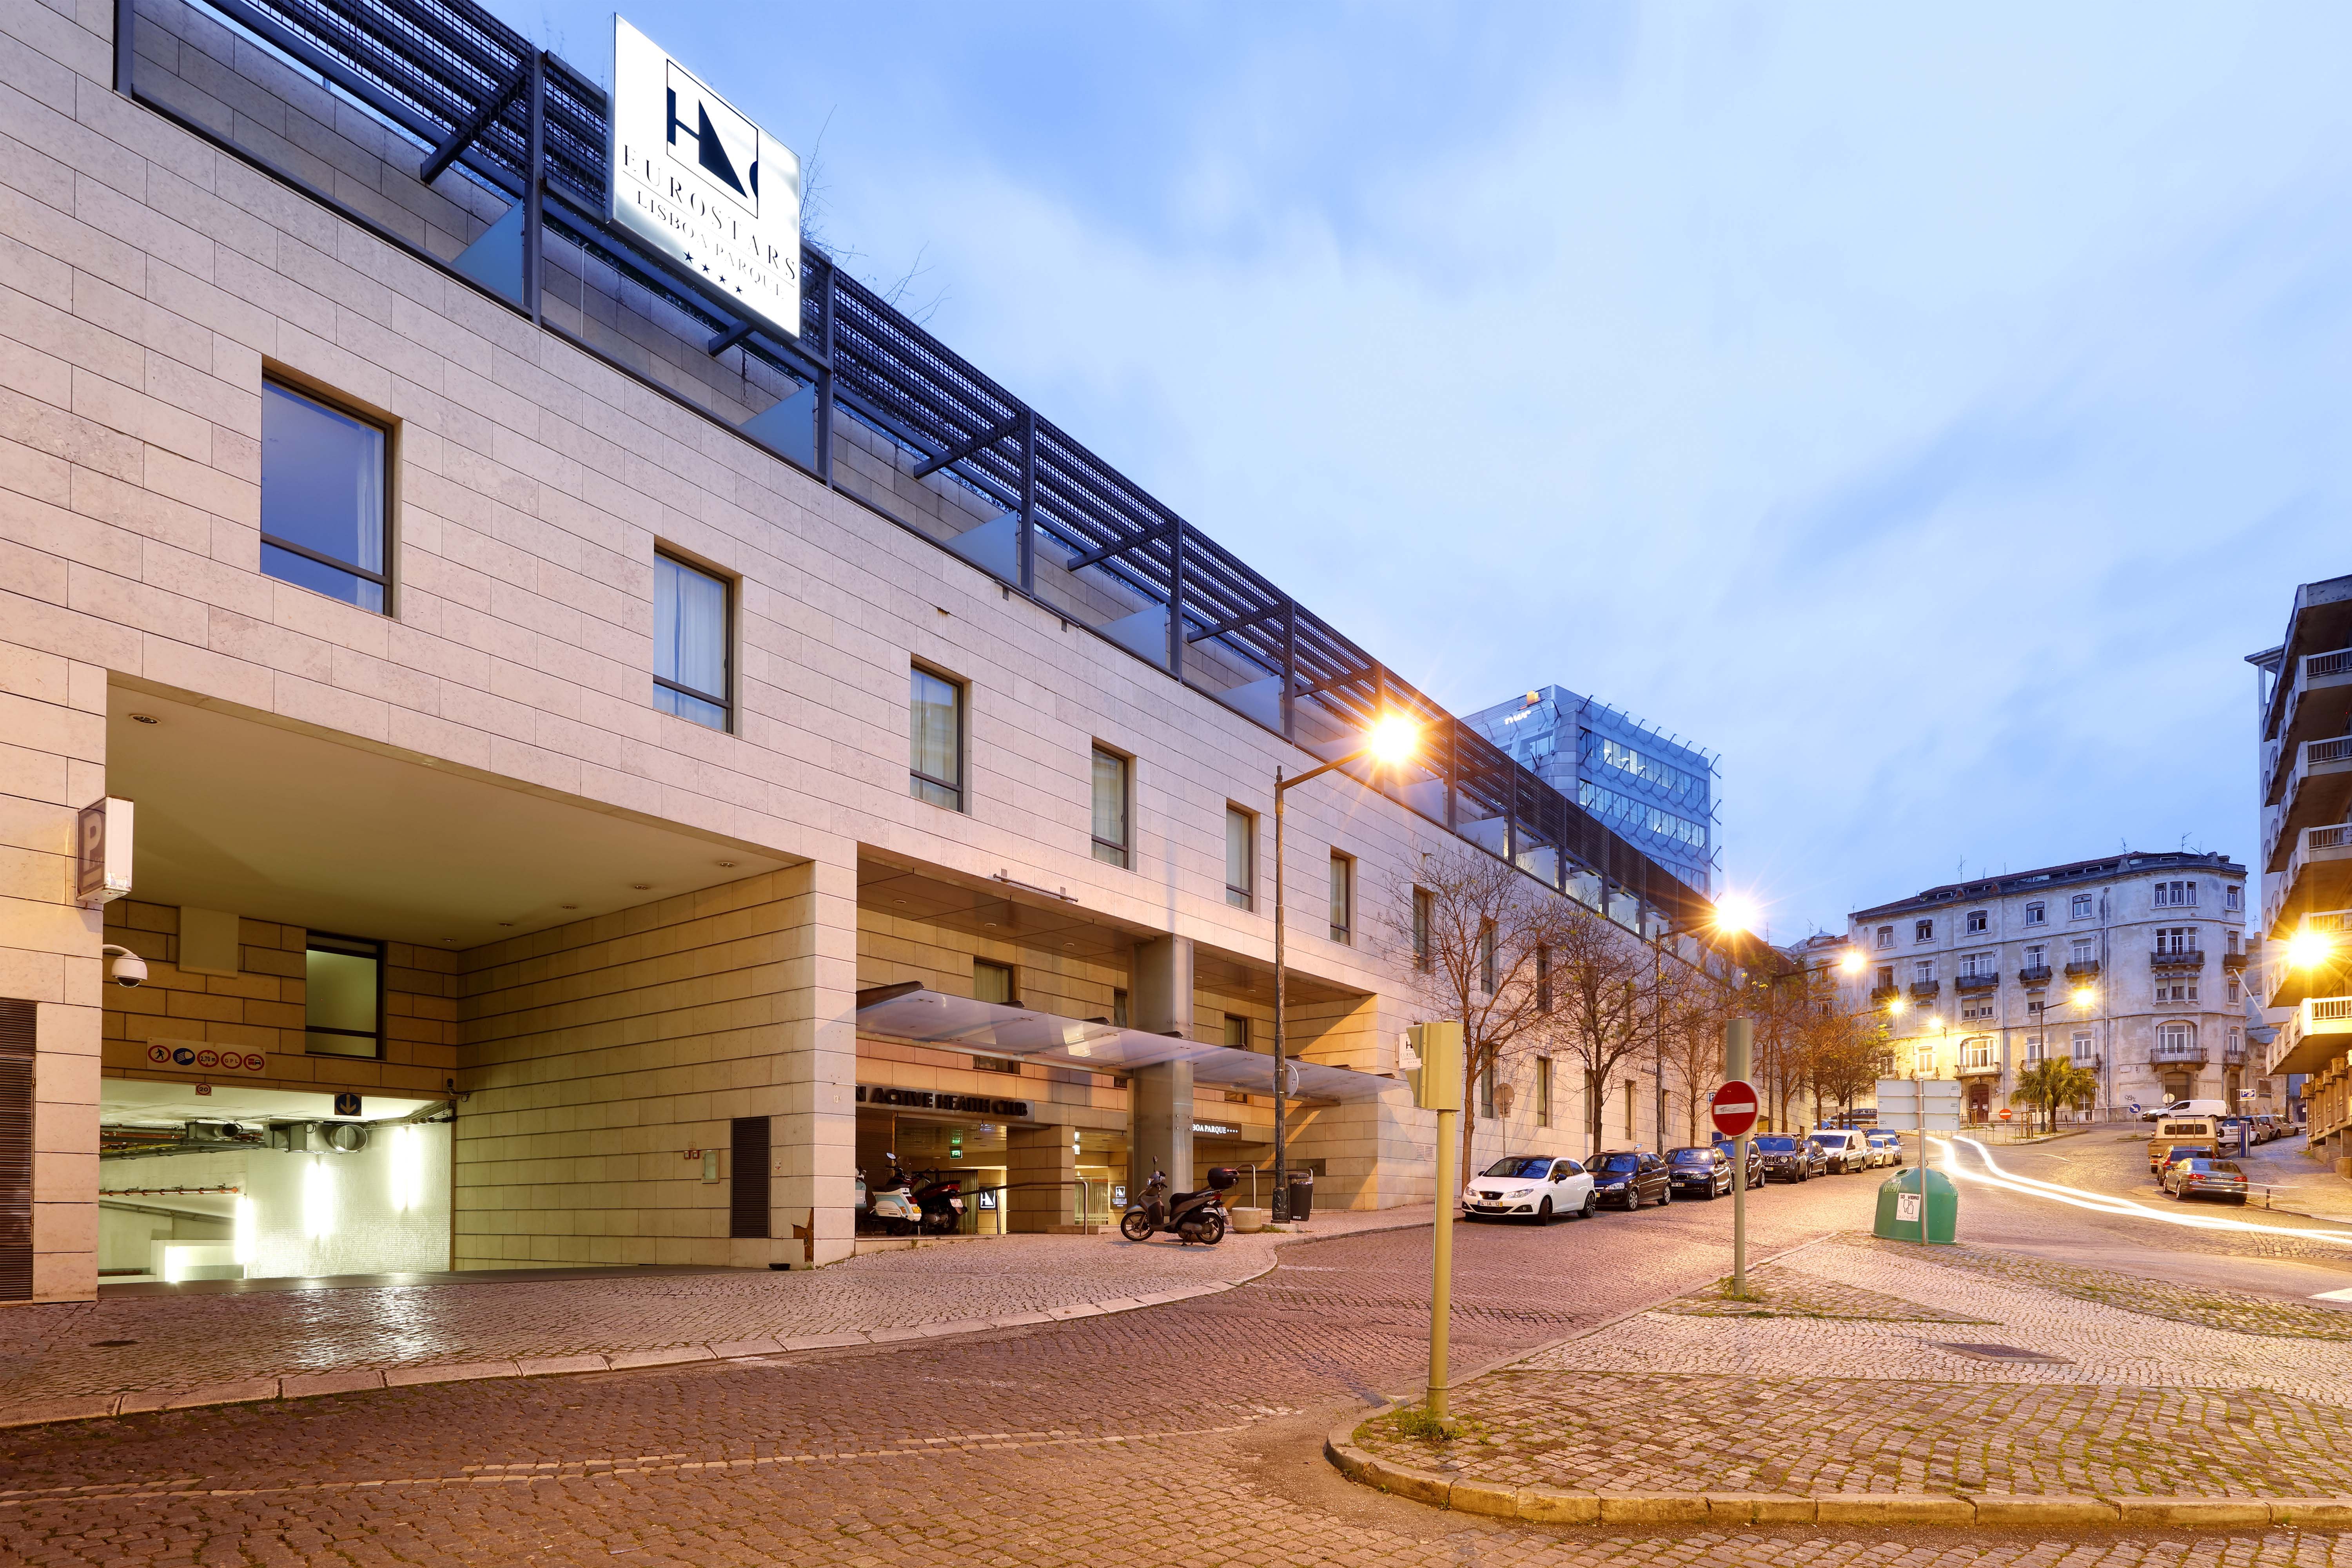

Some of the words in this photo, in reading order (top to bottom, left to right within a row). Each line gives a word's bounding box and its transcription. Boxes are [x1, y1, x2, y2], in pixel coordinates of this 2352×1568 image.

[624, 144, 795, 279] EUROSTARS
[638, 190, 707, 248] LISBOA
[83, 813, 102, 872] P
[870, 1087, 933, 1108] ACTIVE
[935, 1094, 991, 1113] HEALTH
[992, 1099, 1028, 1117] CLUB
[1204, 1125, 1227, 1135] PARQUE
